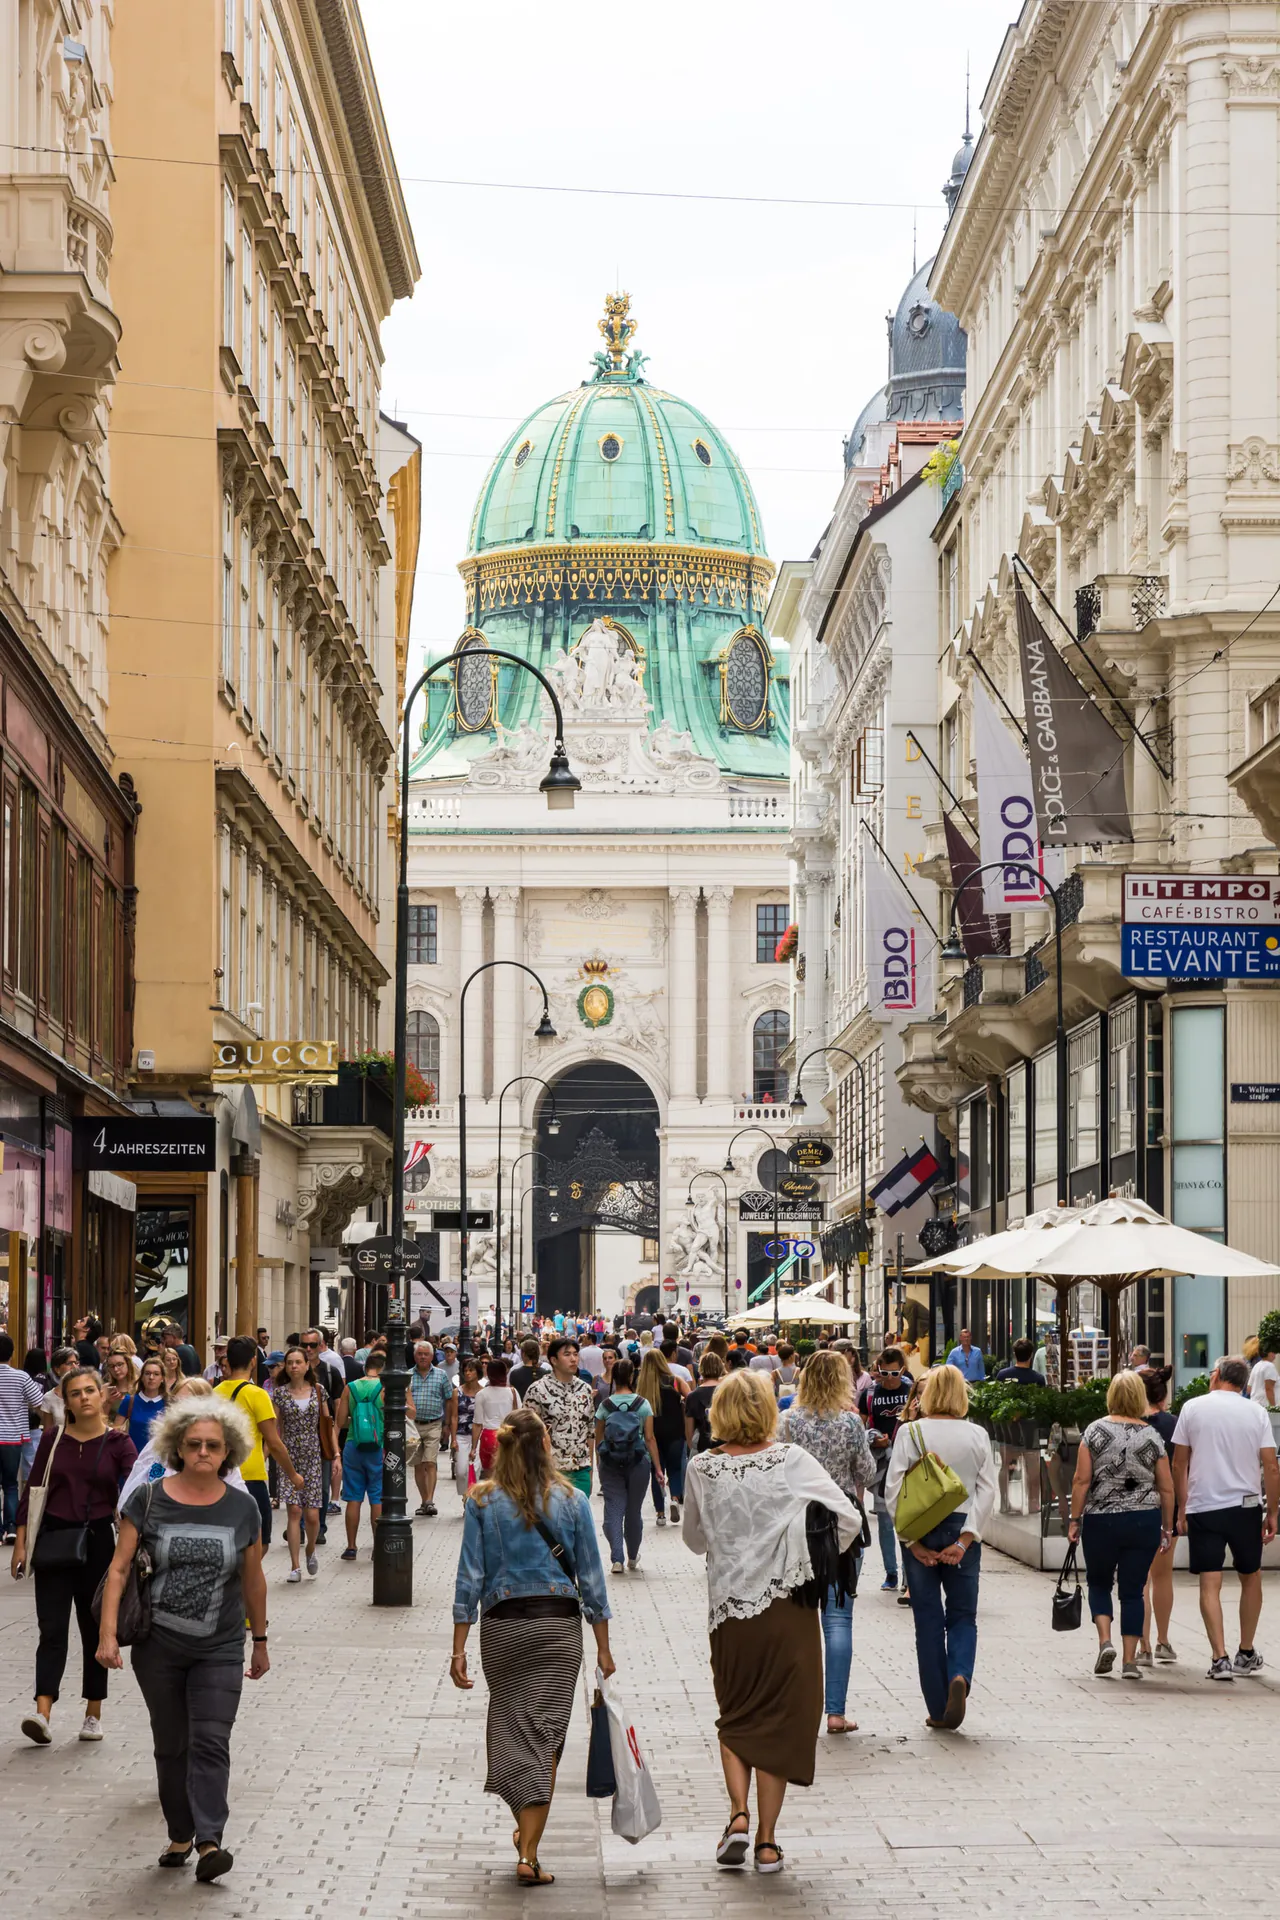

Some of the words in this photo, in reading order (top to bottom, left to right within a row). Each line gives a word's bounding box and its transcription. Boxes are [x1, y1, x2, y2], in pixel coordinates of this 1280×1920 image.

[1026, 640, 1058, 752] GABBANA
[1048, 754, 1059, 763] &
[1040, 766, 1068, 835] DOLCE
[1000, 796, 1036, 891] BDO
[1132, 882, 1155, 897] IL
[1160, 882, 1266, 898] TEMPO
[1131, 930, 1260, 946] RESTAURANT
[883, 927, 909, 1000] BDO
[1131, 949, 1260, 973] LEVANTE
[218, 1045, 333, 1065] GUCCI
[93, 1127, 107, 1154] 4
[109, 1143, 206, 1155] JAHRESZEITEN
[797, 1148, 824, 1156] DEMEL
[782, 1180, 816, 1192] Chopard
[404, 1198, 469, 1211] APOTHEK
[357, 1249, 378, 1264] GS
[874, 1394, 908, 1406] OLLISTE
